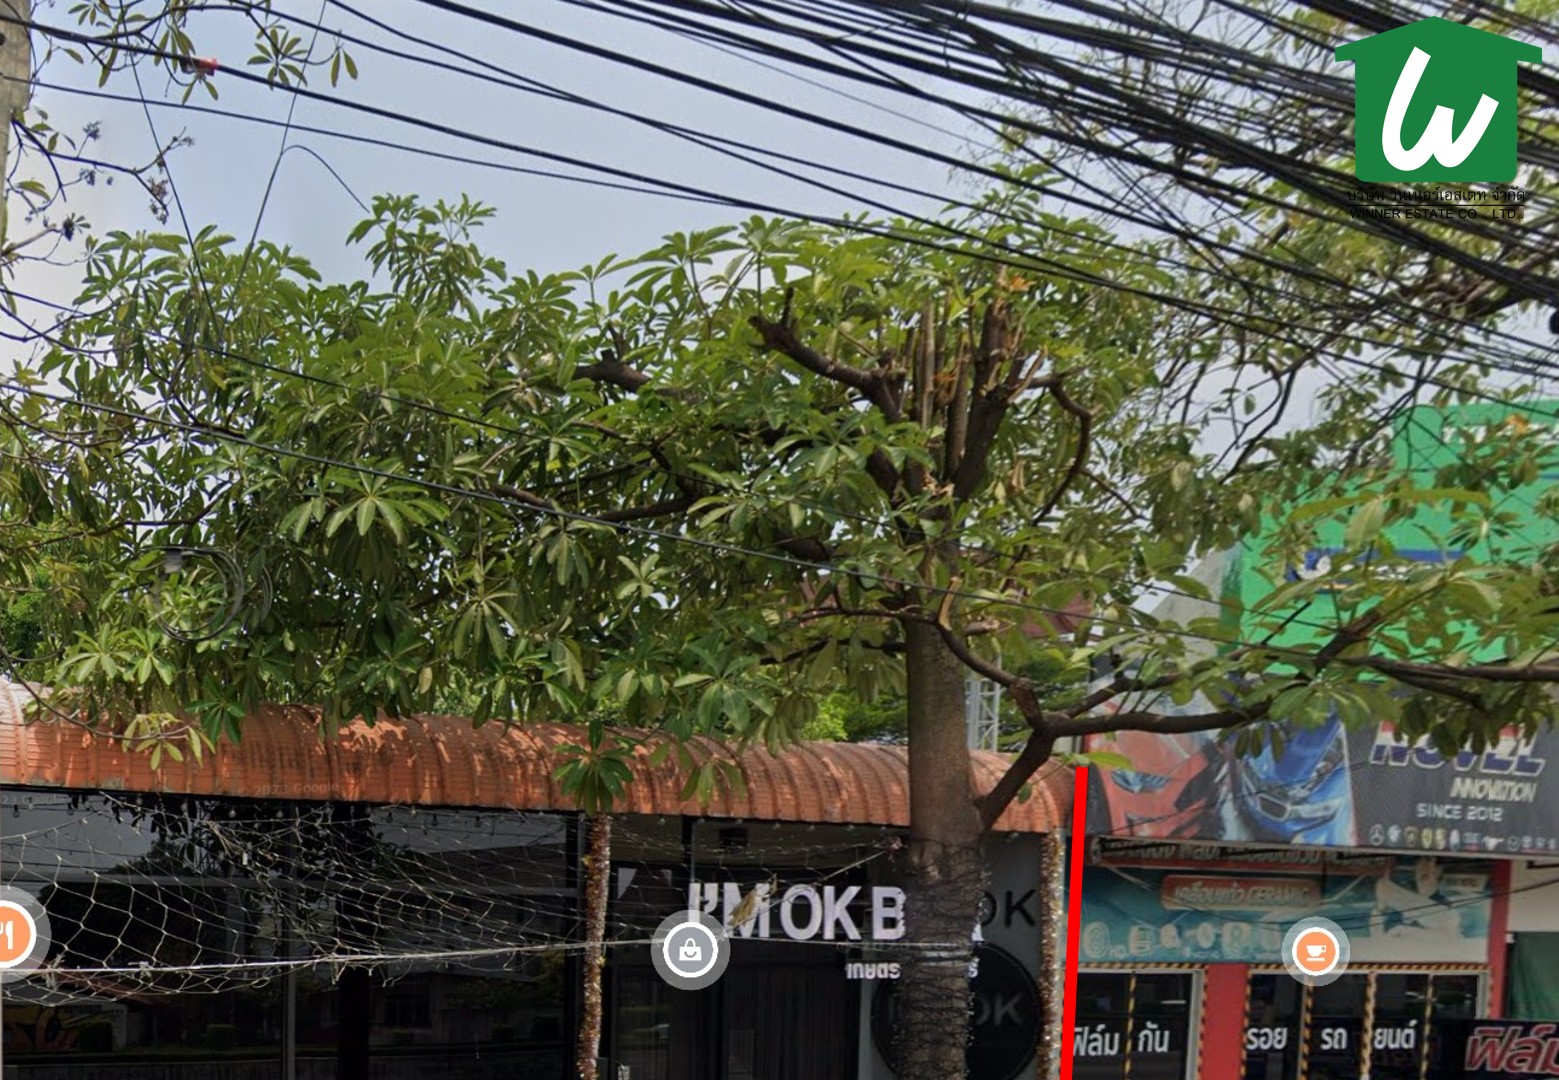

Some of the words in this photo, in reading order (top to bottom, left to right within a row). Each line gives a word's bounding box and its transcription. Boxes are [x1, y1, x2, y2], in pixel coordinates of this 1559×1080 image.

[1416, 803, 1462, 820] SINCE
[1466, 806, 1503, 821] 2012
[780, 886, 863, 941] OK
[1137, 1021, 1170, 1053] กัน
[1247, 1027, 1288, 1050] รอย
[1320, 1027, 1347, 1050] รถ
[1374, 1018, 1418, 1050] ยนต์
